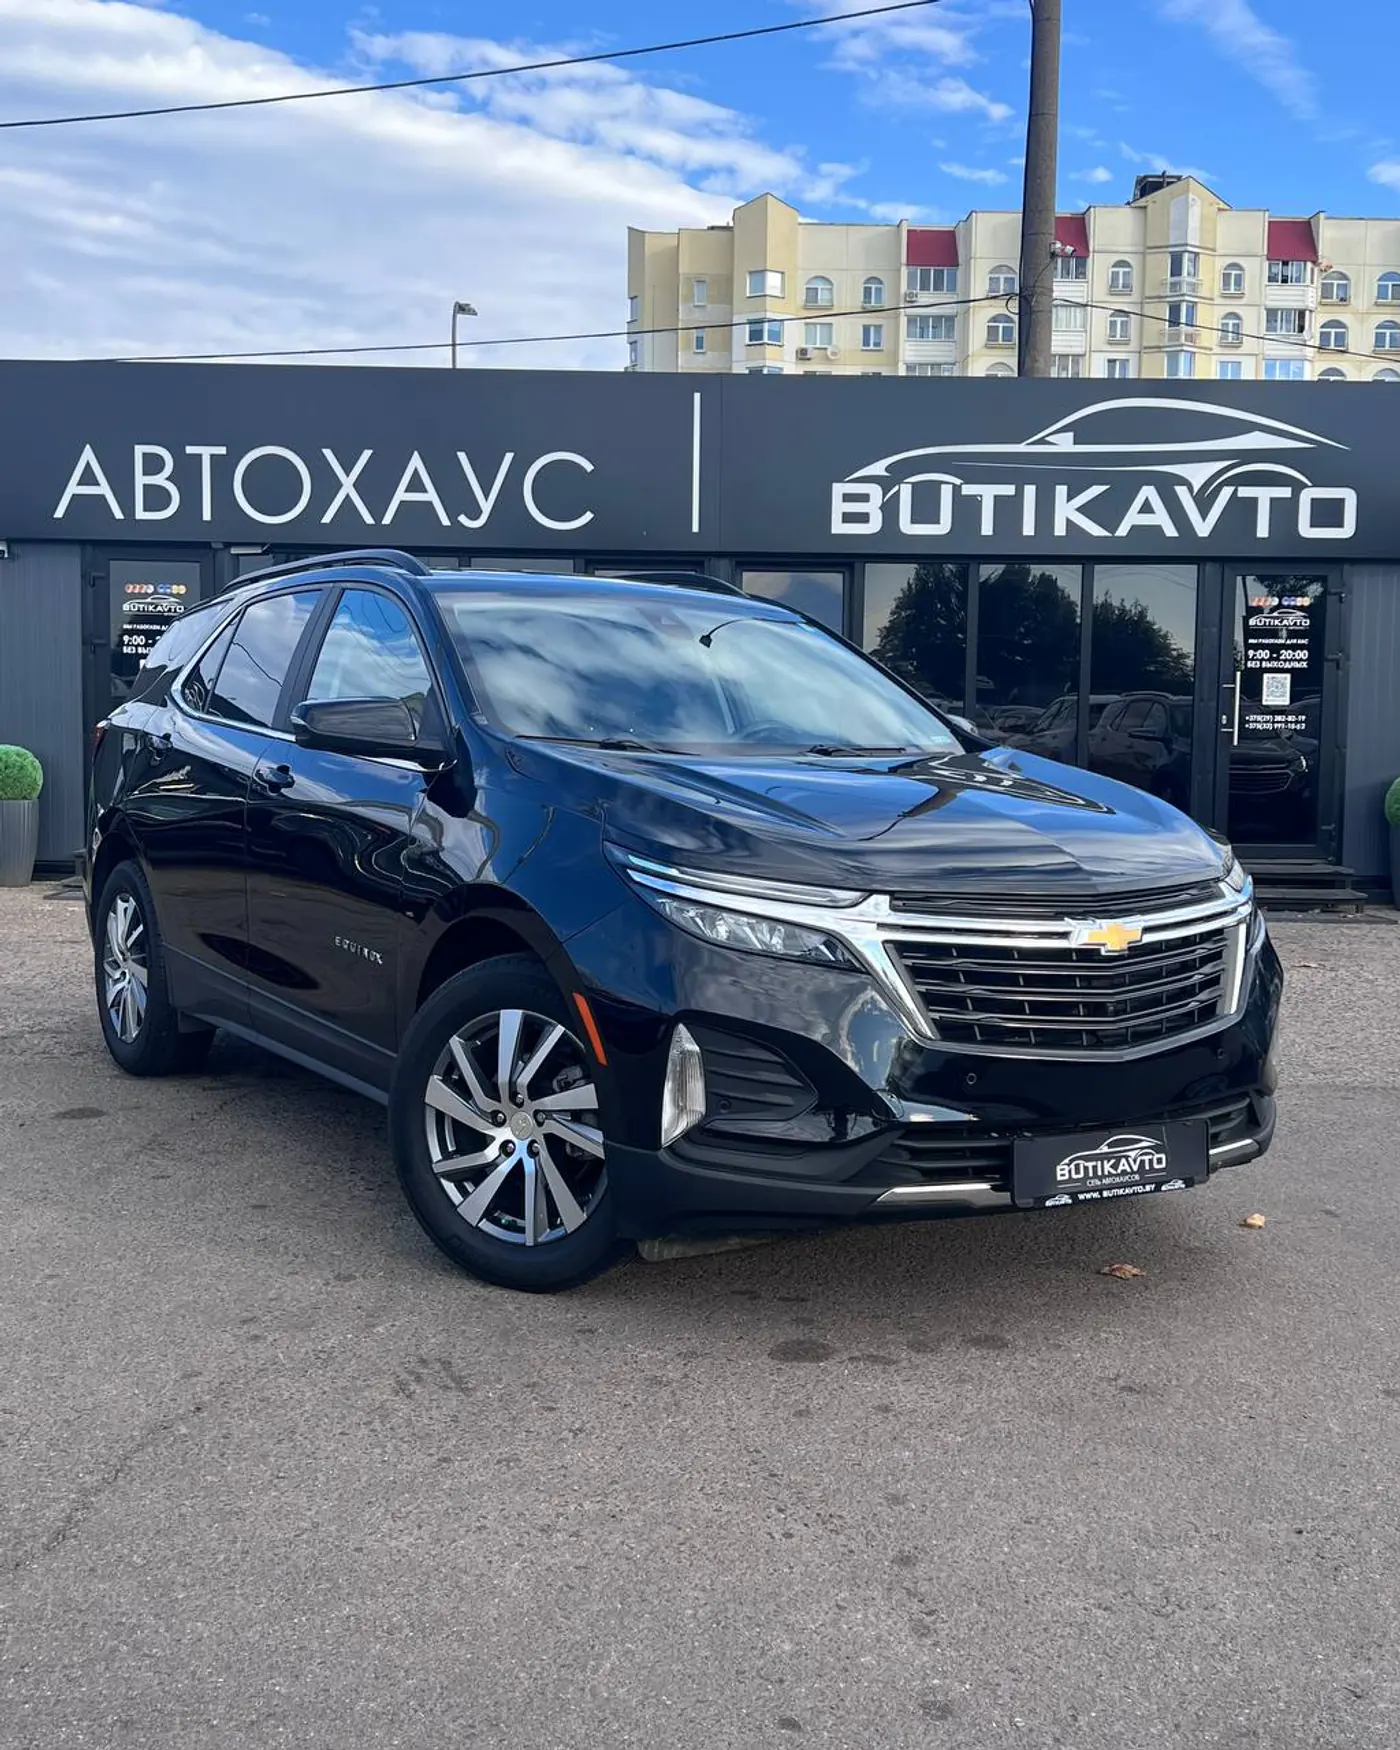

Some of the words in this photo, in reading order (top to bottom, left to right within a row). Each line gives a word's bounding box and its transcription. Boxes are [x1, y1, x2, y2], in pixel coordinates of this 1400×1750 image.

[53, 443, 595, 530] АВТОХАУС
[831, 482, 1357, 539] BUTIKAVTO
[122, 603, 185, 613] BUTIKAVTO
[1248, 618, 1310, 626] BUTIKAVTO
[123, 634, 145, 645] 9:00
[1248, 650, 1270, 659] 9:00
[1279, 650, 1309, 660] 20:00
[1262, 661, 1309, 669] ВЫХОДНЫХ
[1056, 1153, 1167, 1181] BUTIKAVTO
